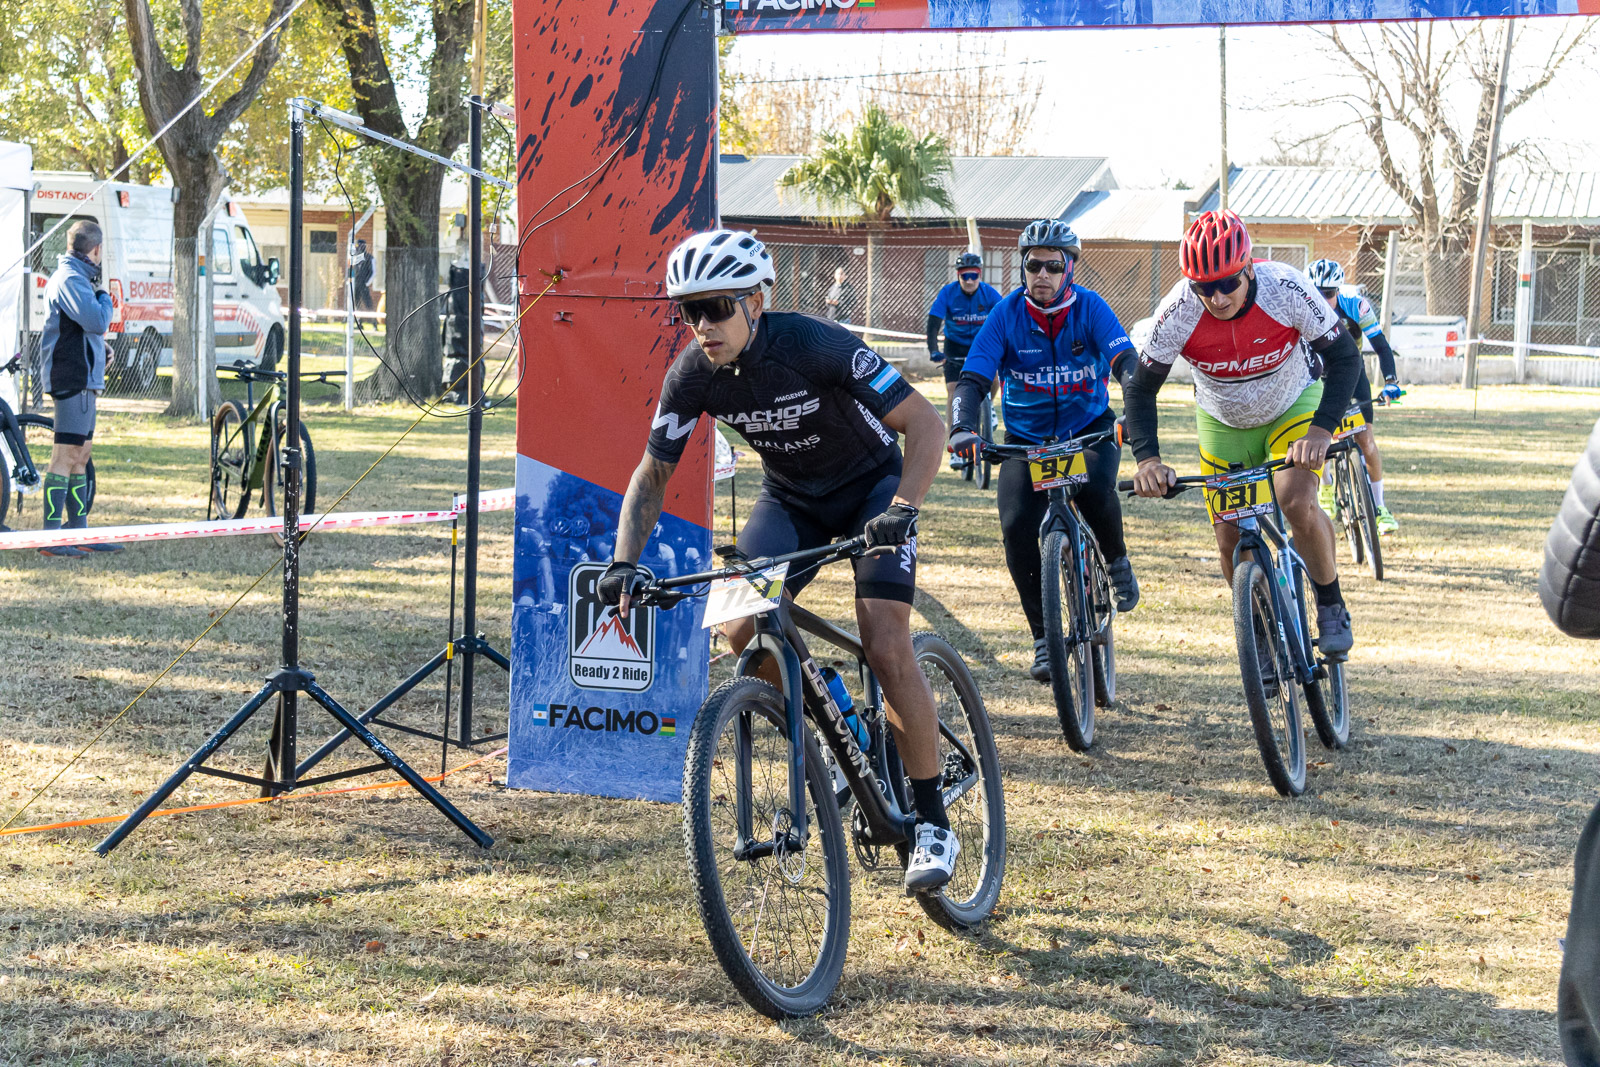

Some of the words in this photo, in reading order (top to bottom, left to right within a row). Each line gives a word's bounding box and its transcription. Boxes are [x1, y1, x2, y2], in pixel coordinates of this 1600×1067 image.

[1280, 278, 1326, 324] TOPMEGA
[1150, 298, 1186, 346] TOPMEGA
[1186, 341, 1293, 374] TOPMEGA
[1010, 364, 1096, 384] PELOTON
[716, 398, 820, 424] NACHOS
[745, 418, 800, 434] BIKE
[1041, 454, 1075, 480] 97
[1218, 483, 1256, 512] 131
[574, 664, 610, 679] Ready
[612, 666, 620, 680] 2
[622, 667, 648, 681] Ride
[550, 704, 658, 734] FACIMO
